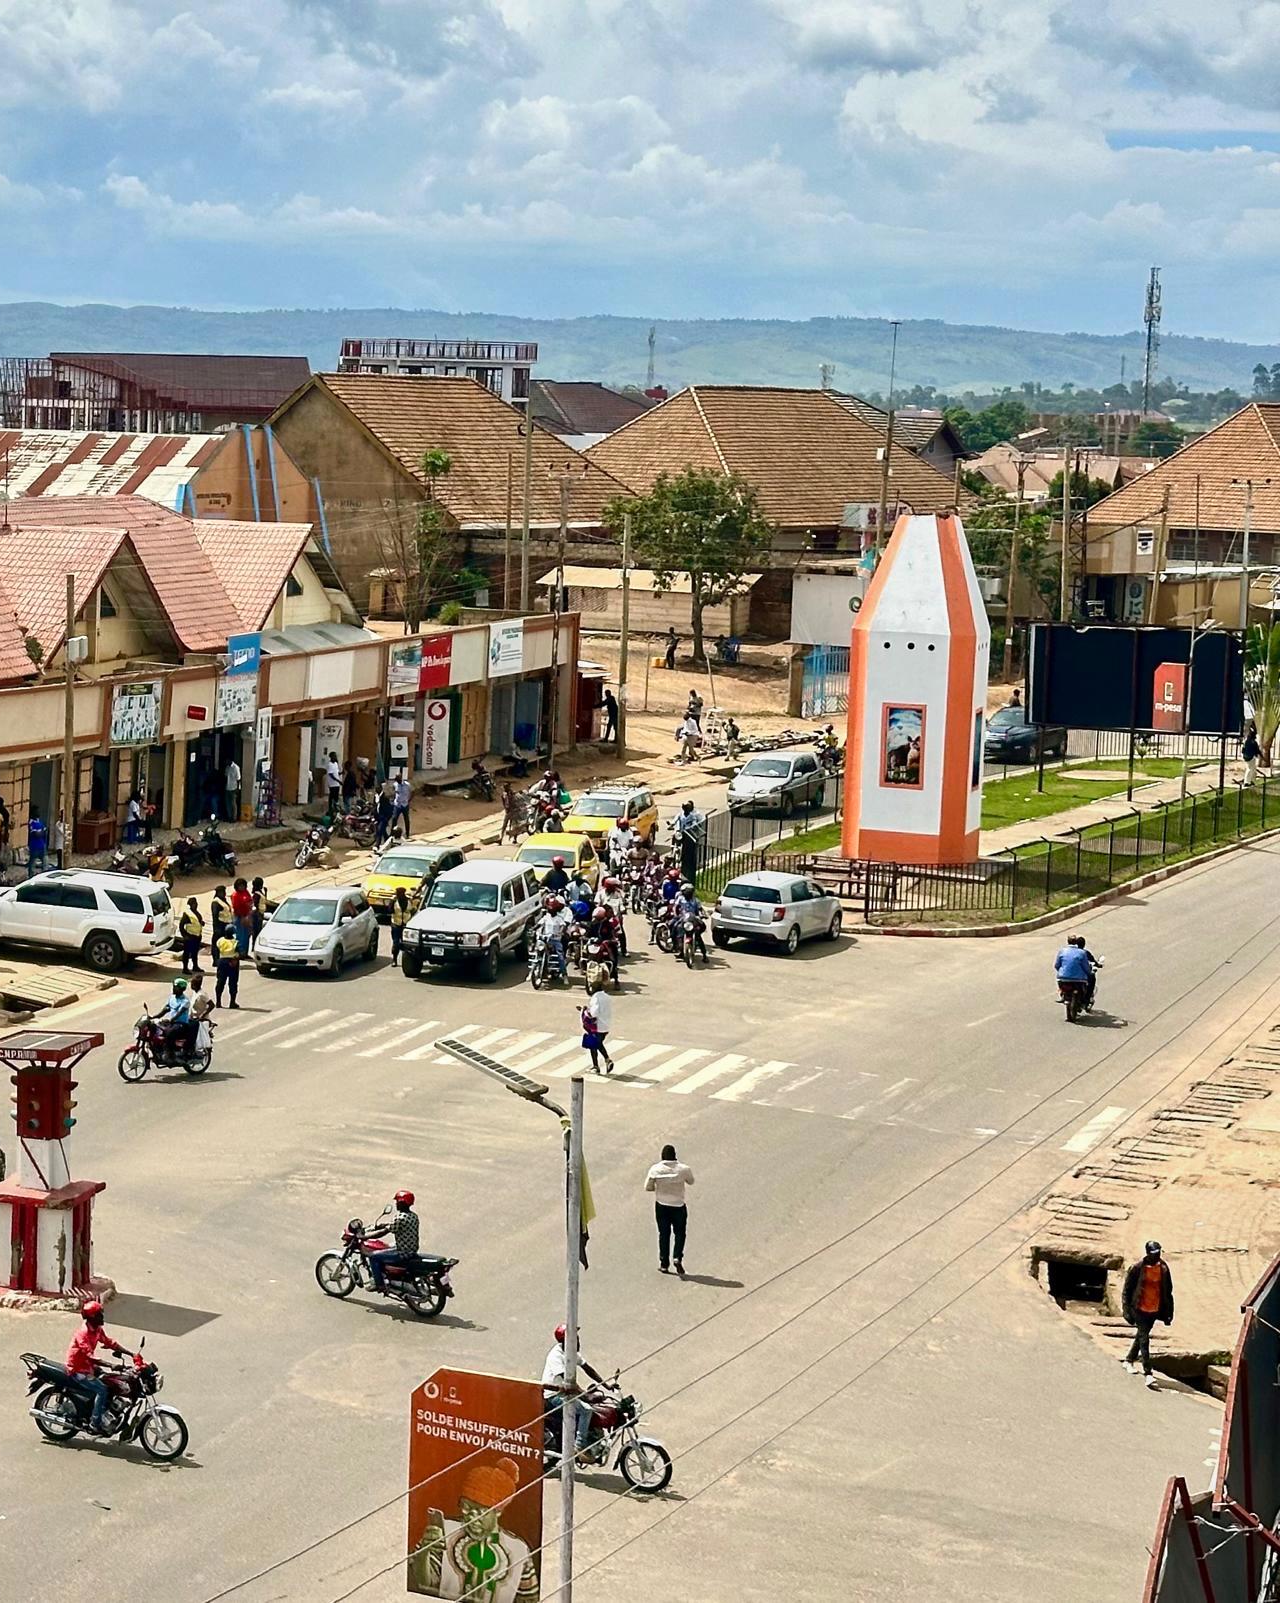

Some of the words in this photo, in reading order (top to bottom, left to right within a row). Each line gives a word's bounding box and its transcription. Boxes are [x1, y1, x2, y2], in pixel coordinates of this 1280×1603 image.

[1154, 702, 1182, 713] m-pesa
[425, 723, 436, 766] vodacom
[416, 1409, 454, 1427] SOLDE
[455, 1417, 531, 1444] INSUFFISANT
[416, 1423, 447, 1440] POUR
[449, 1429, 484, 1447] ENVOI
[486, 1439, 533, 1458] ARGENT
[534, 1449, 541, 1460] ?
